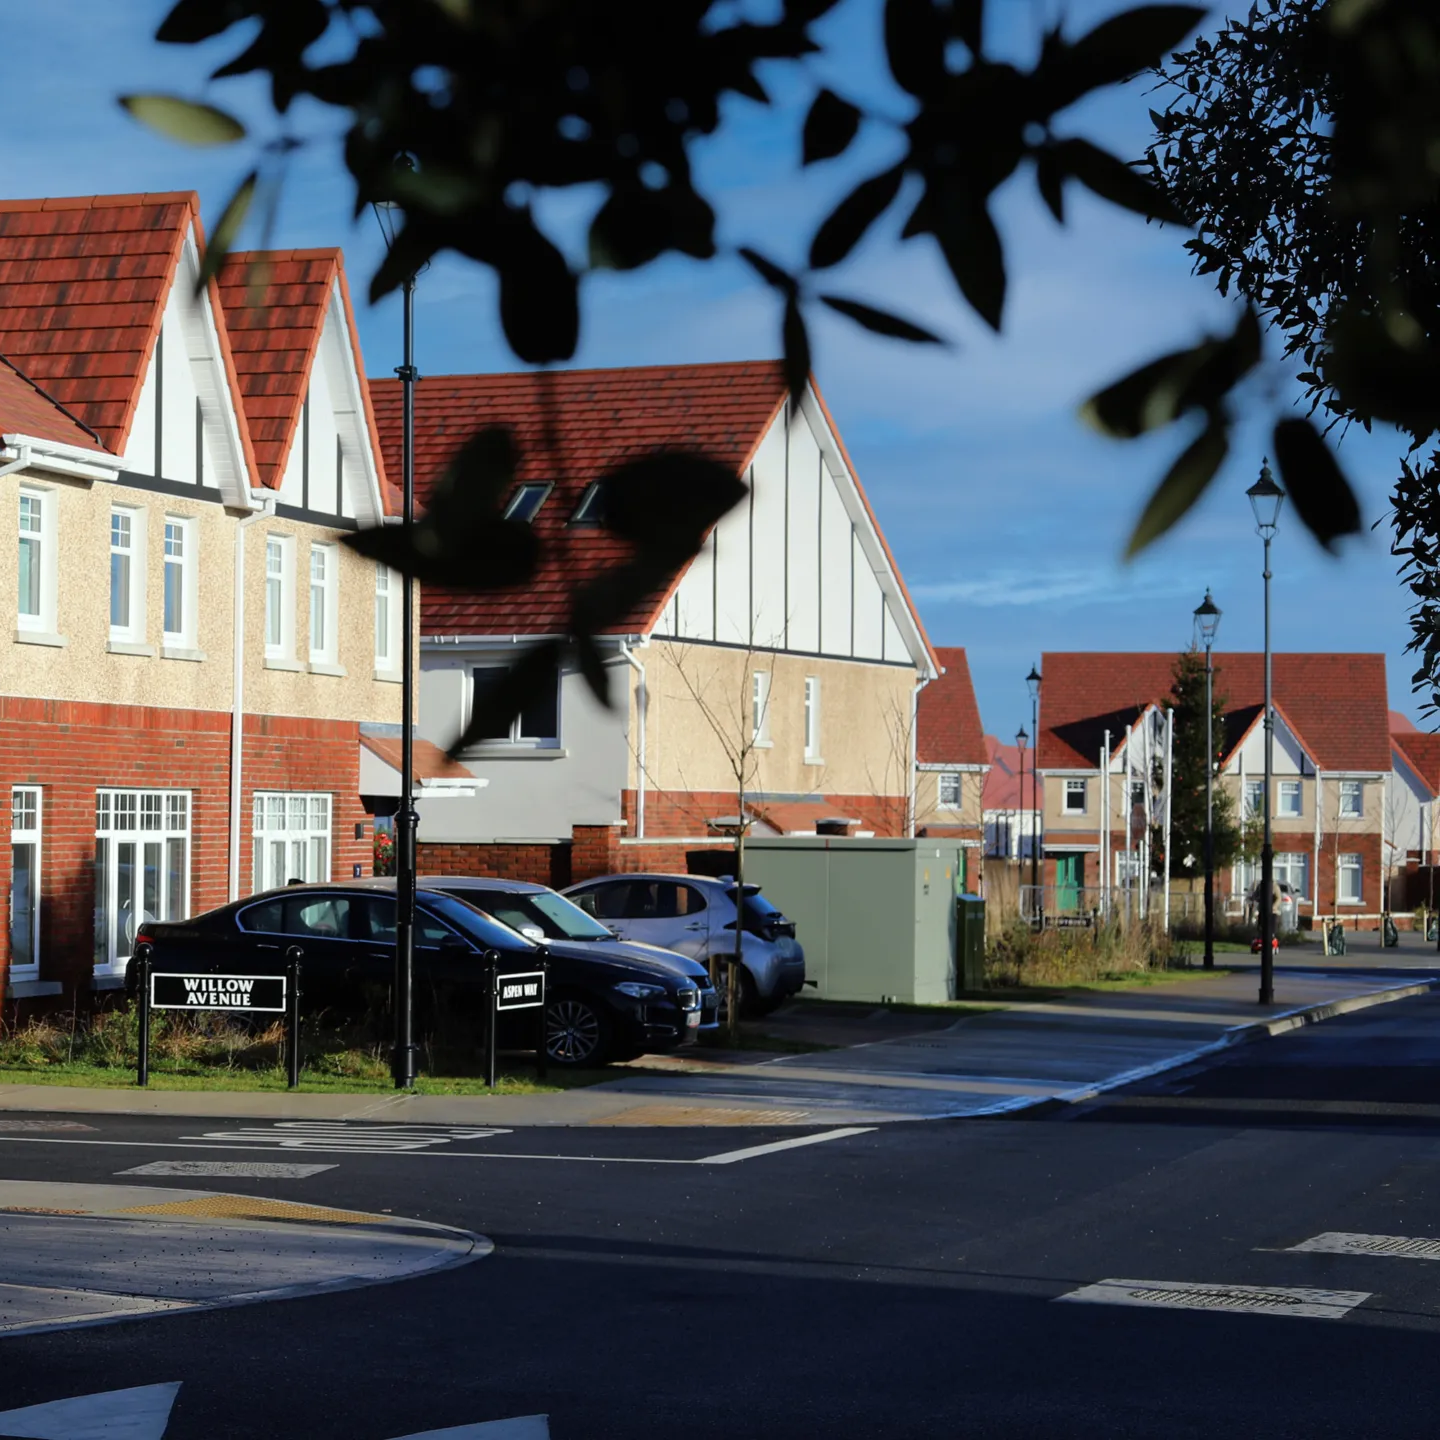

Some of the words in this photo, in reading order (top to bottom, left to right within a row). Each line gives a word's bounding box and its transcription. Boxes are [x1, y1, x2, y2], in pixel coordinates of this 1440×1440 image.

[183, 978, 255, 992] WILLOW
[502, 984, 523, 999] ASPEN
[523, 982, 538, 996] WAY
[186, 992, 252, 1006] AVENUE
